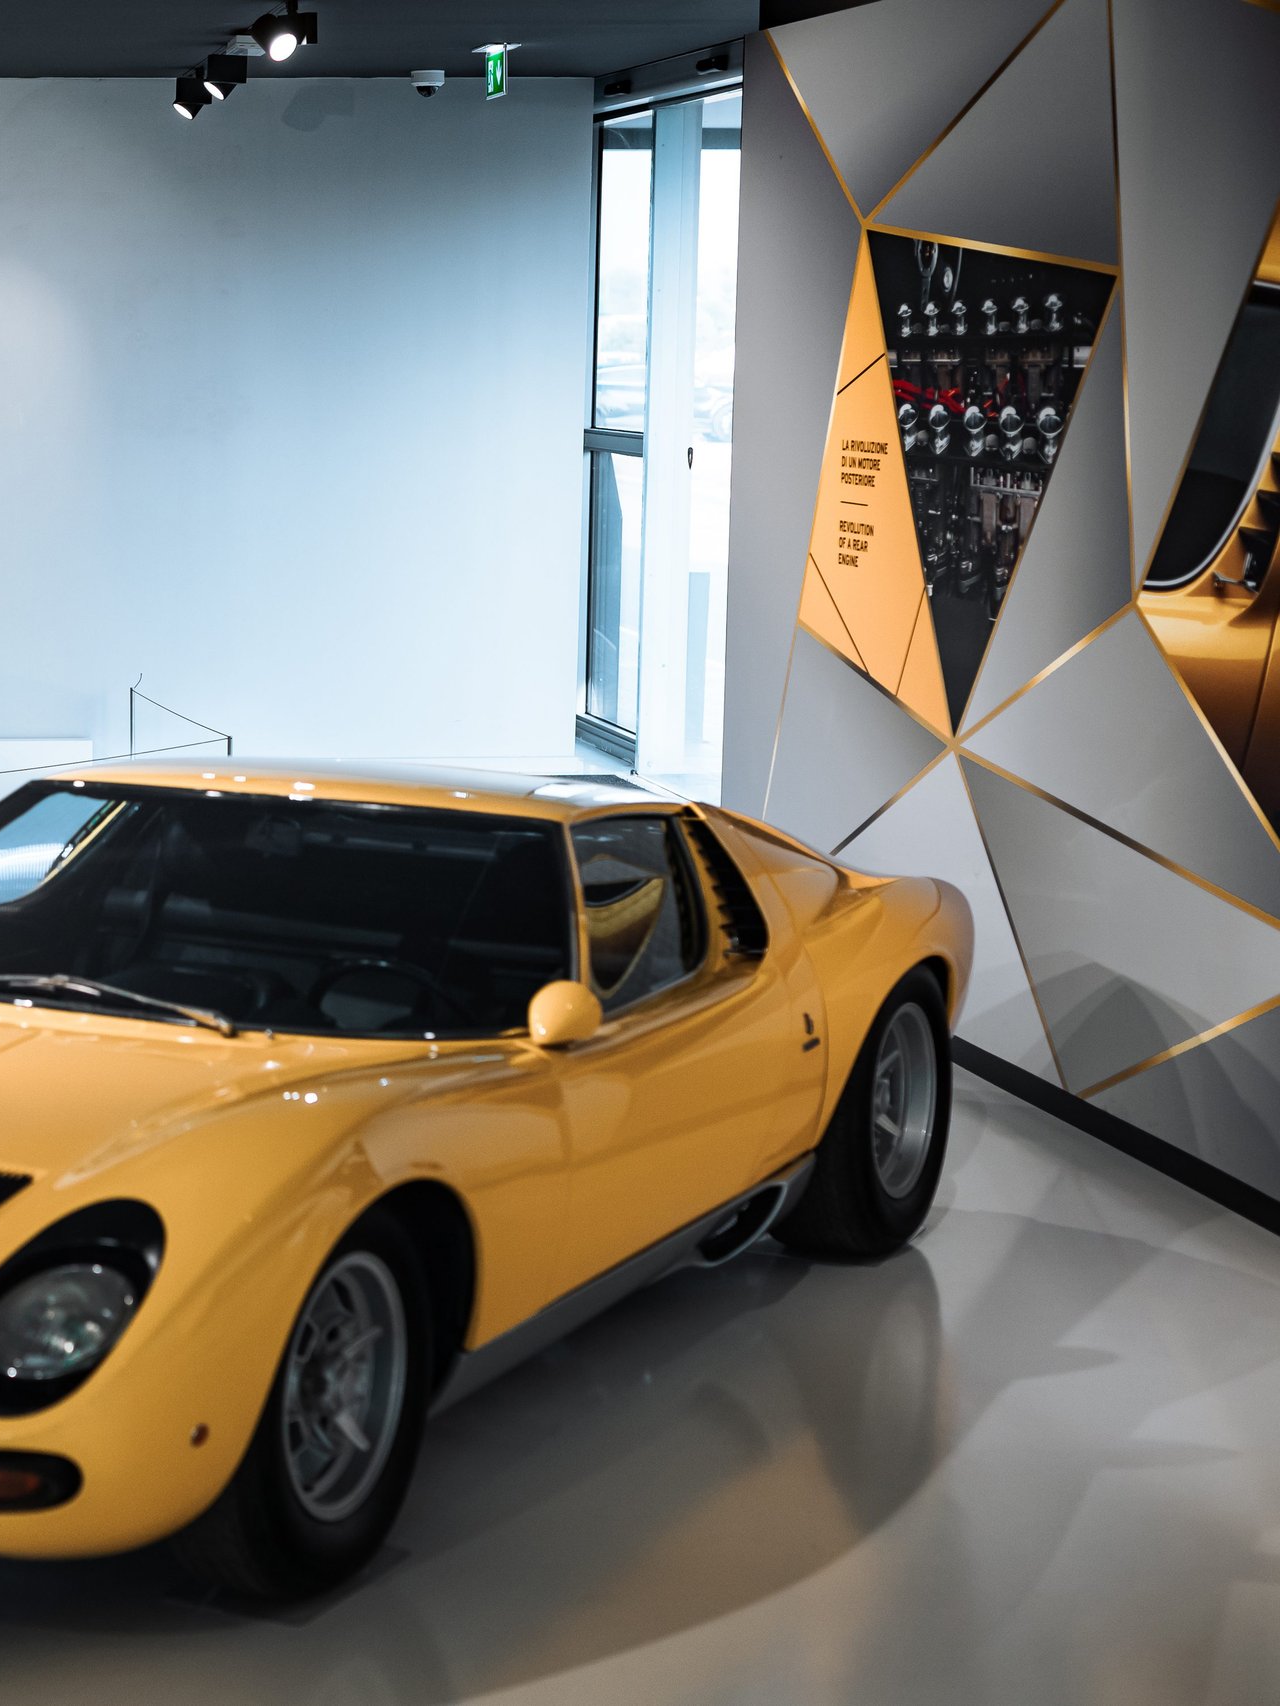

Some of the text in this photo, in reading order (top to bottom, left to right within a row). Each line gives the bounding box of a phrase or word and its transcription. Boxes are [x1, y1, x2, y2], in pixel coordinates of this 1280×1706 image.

[842, 439, 888, 455] LA RIVOLUZIONE
[842, 456, 881, 471] DI UN MOTORE
[841, 472, 875, 487] POSTERIORE
[839, 520, 874, 536] REVOLUTION
[839, 537, 868, 552] OF A REAR
[838, 553, 858, 567] ENGINE
